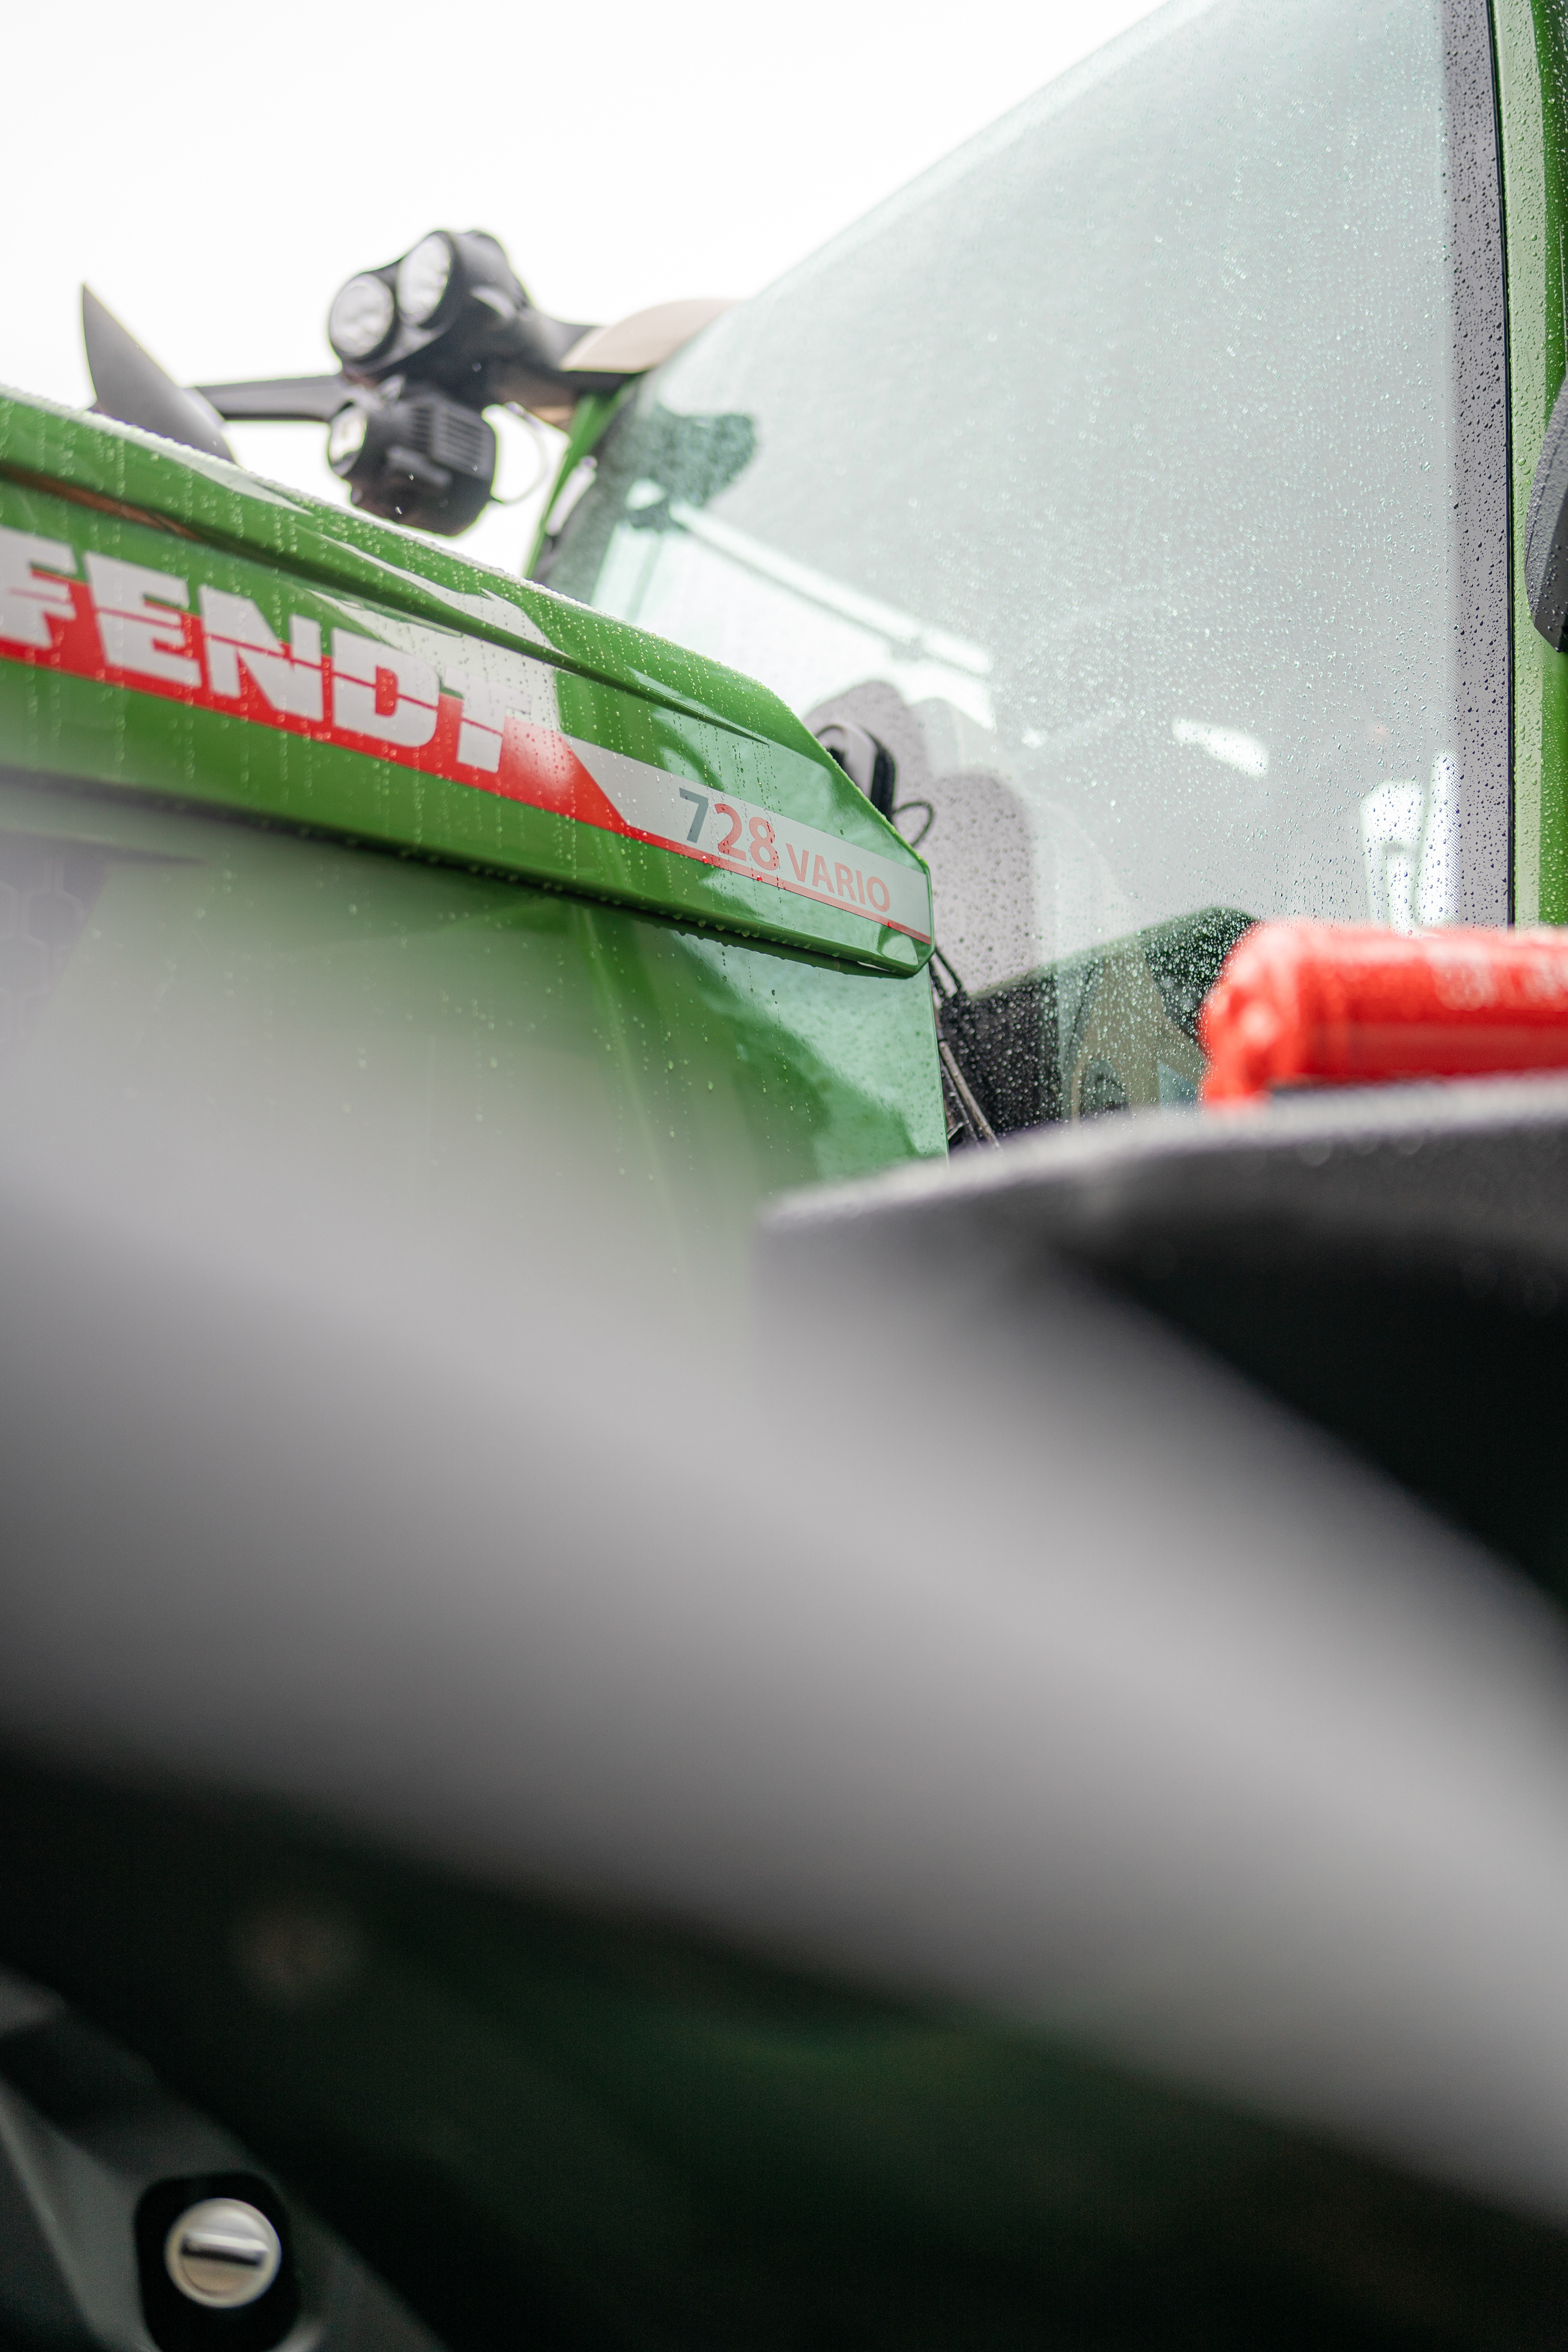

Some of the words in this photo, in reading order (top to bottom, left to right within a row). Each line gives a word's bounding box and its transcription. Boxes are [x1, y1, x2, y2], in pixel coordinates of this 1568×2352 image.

[0, 525, 532, 773] FENDT
[679, 787, 780, 871] 728
[785, 842, 891, 913] VARIO
